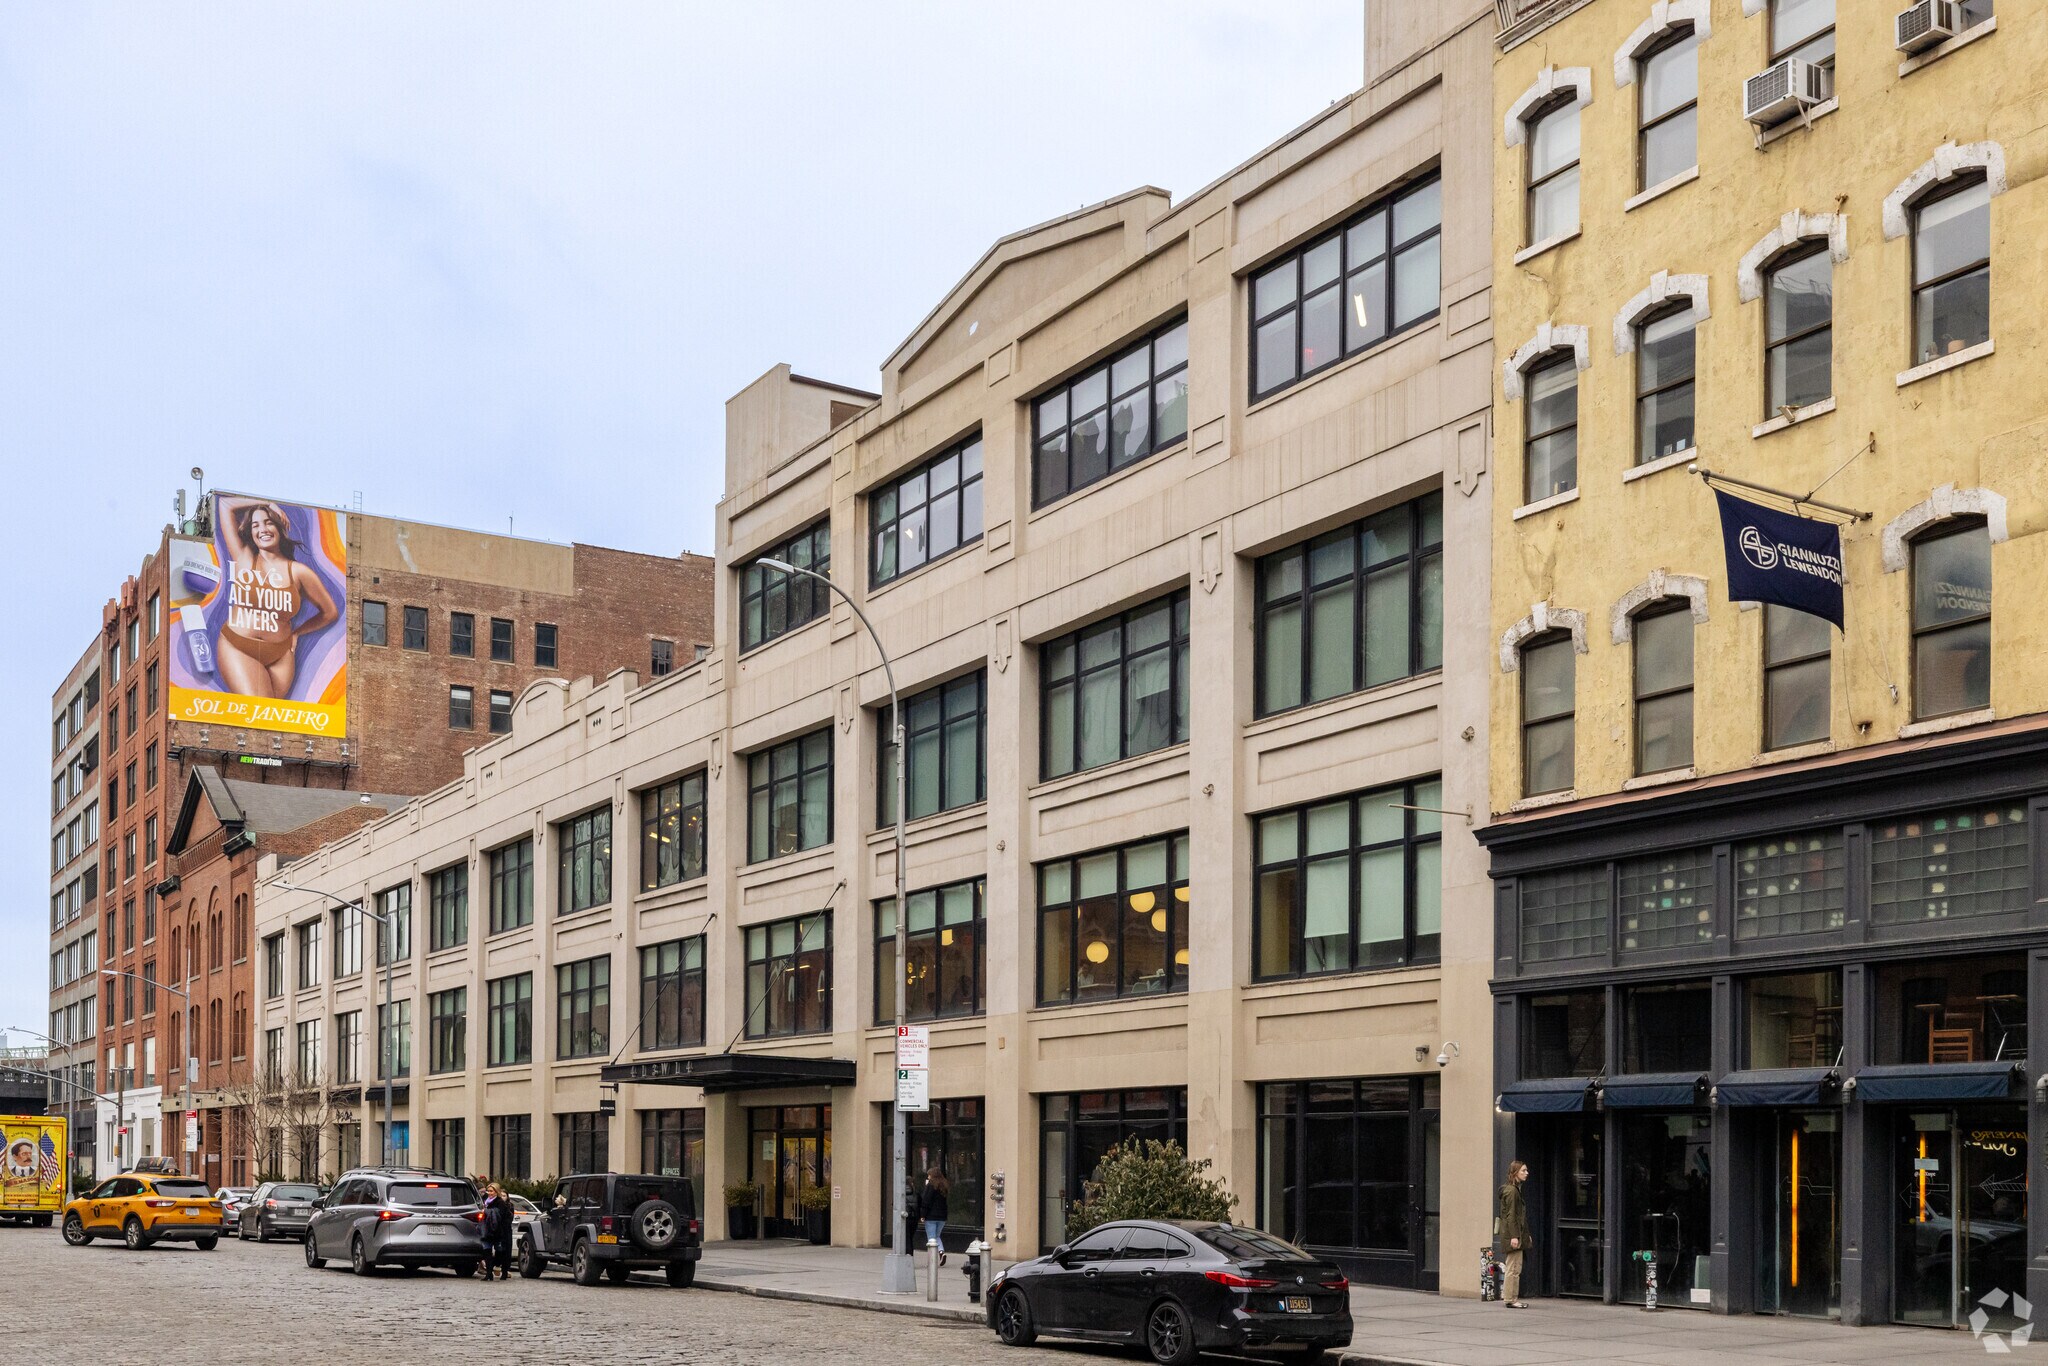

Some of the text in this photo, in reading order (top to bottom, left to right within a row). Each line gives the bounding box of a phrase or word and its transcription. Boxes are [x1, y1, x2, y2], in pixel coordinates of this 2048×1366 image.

[1777, 543, 1840, 571] GIANNUZZI
[228, 560, 283, 588] Love
[1782, 556, 1842, 587] LEWENDON
[229, 584, 292, 612] ALL YOUR
[229, 606, 279, 633] LAYERS
[185, 698, 329, 731] SOL DE JANEIRO
[901, 1027, 907, 1036] 3
[900, 1070, 906, 1079] 2
